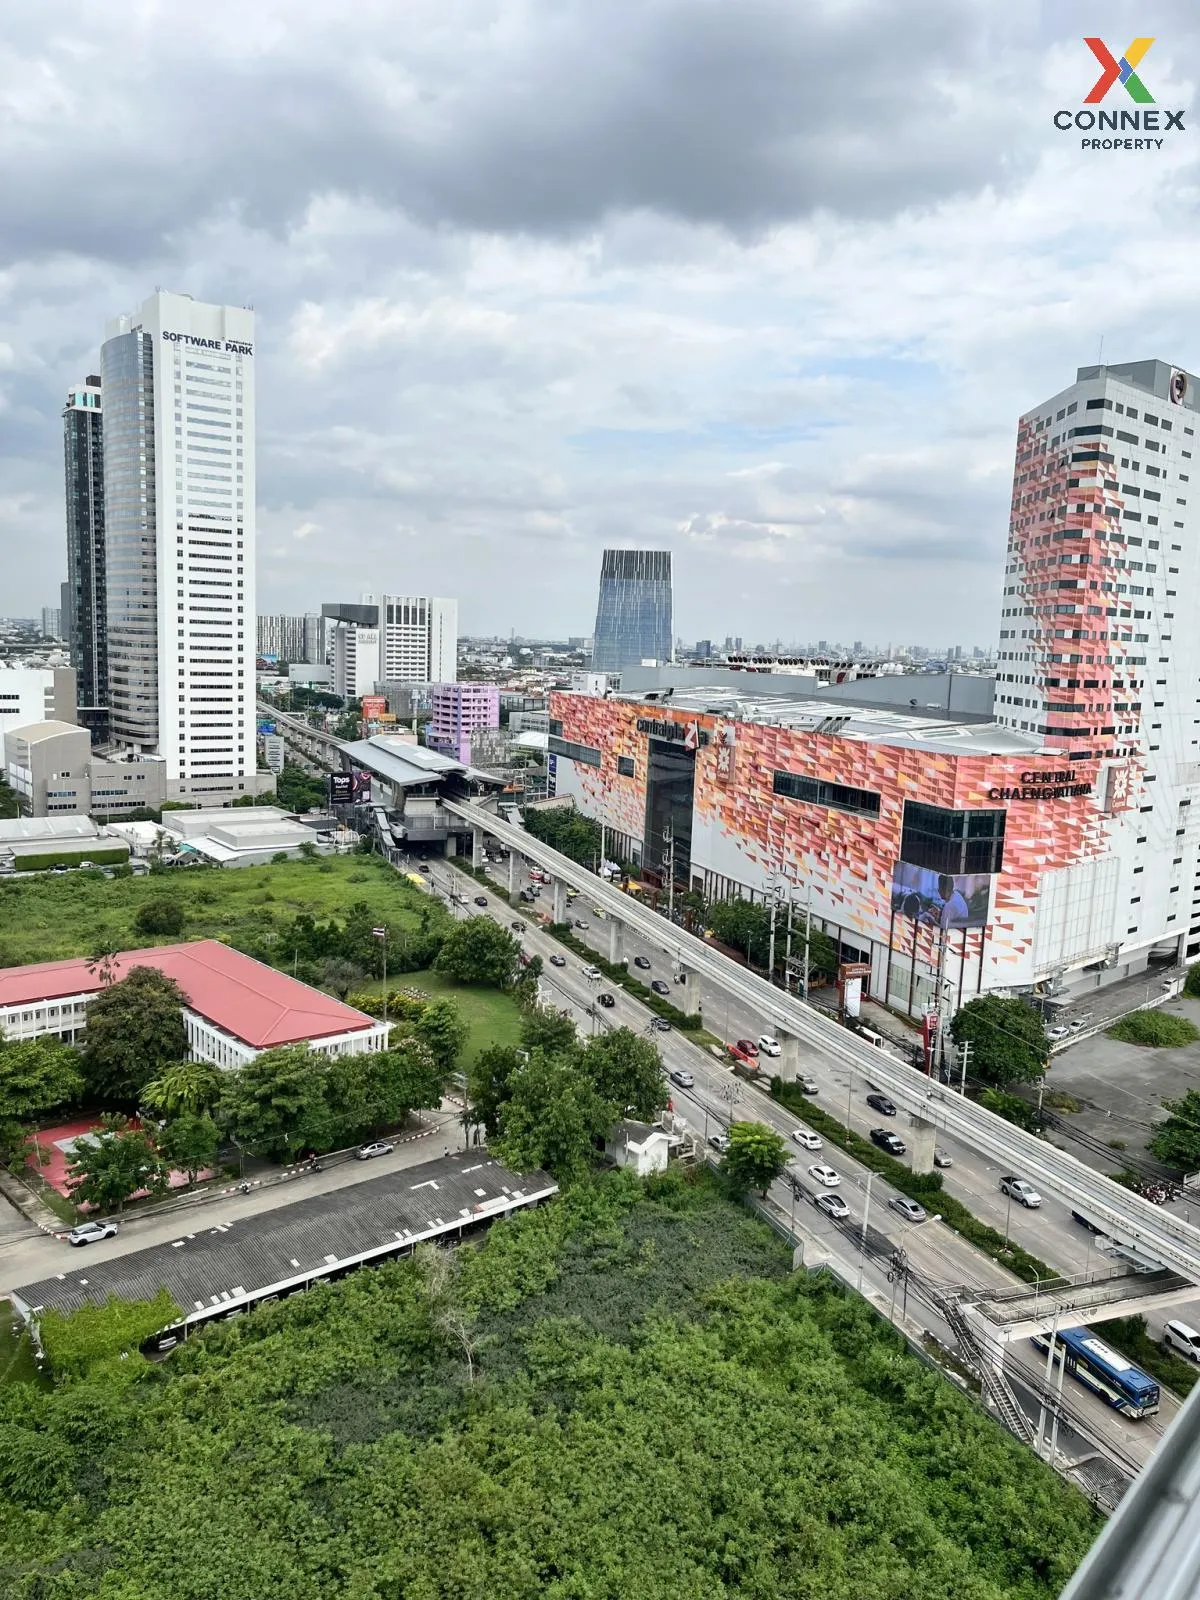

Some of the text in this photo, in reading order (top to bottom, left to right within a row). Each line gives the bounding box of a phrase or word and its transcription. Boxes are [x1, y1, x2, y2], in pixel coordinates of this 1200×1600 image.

[162, 330, 221, 350] SOFTWARE
[225, 342, 254, 356] PARK
[333, 776, 350, 785] Tops
[1021, 769, 1078, 784] CENTRAL
